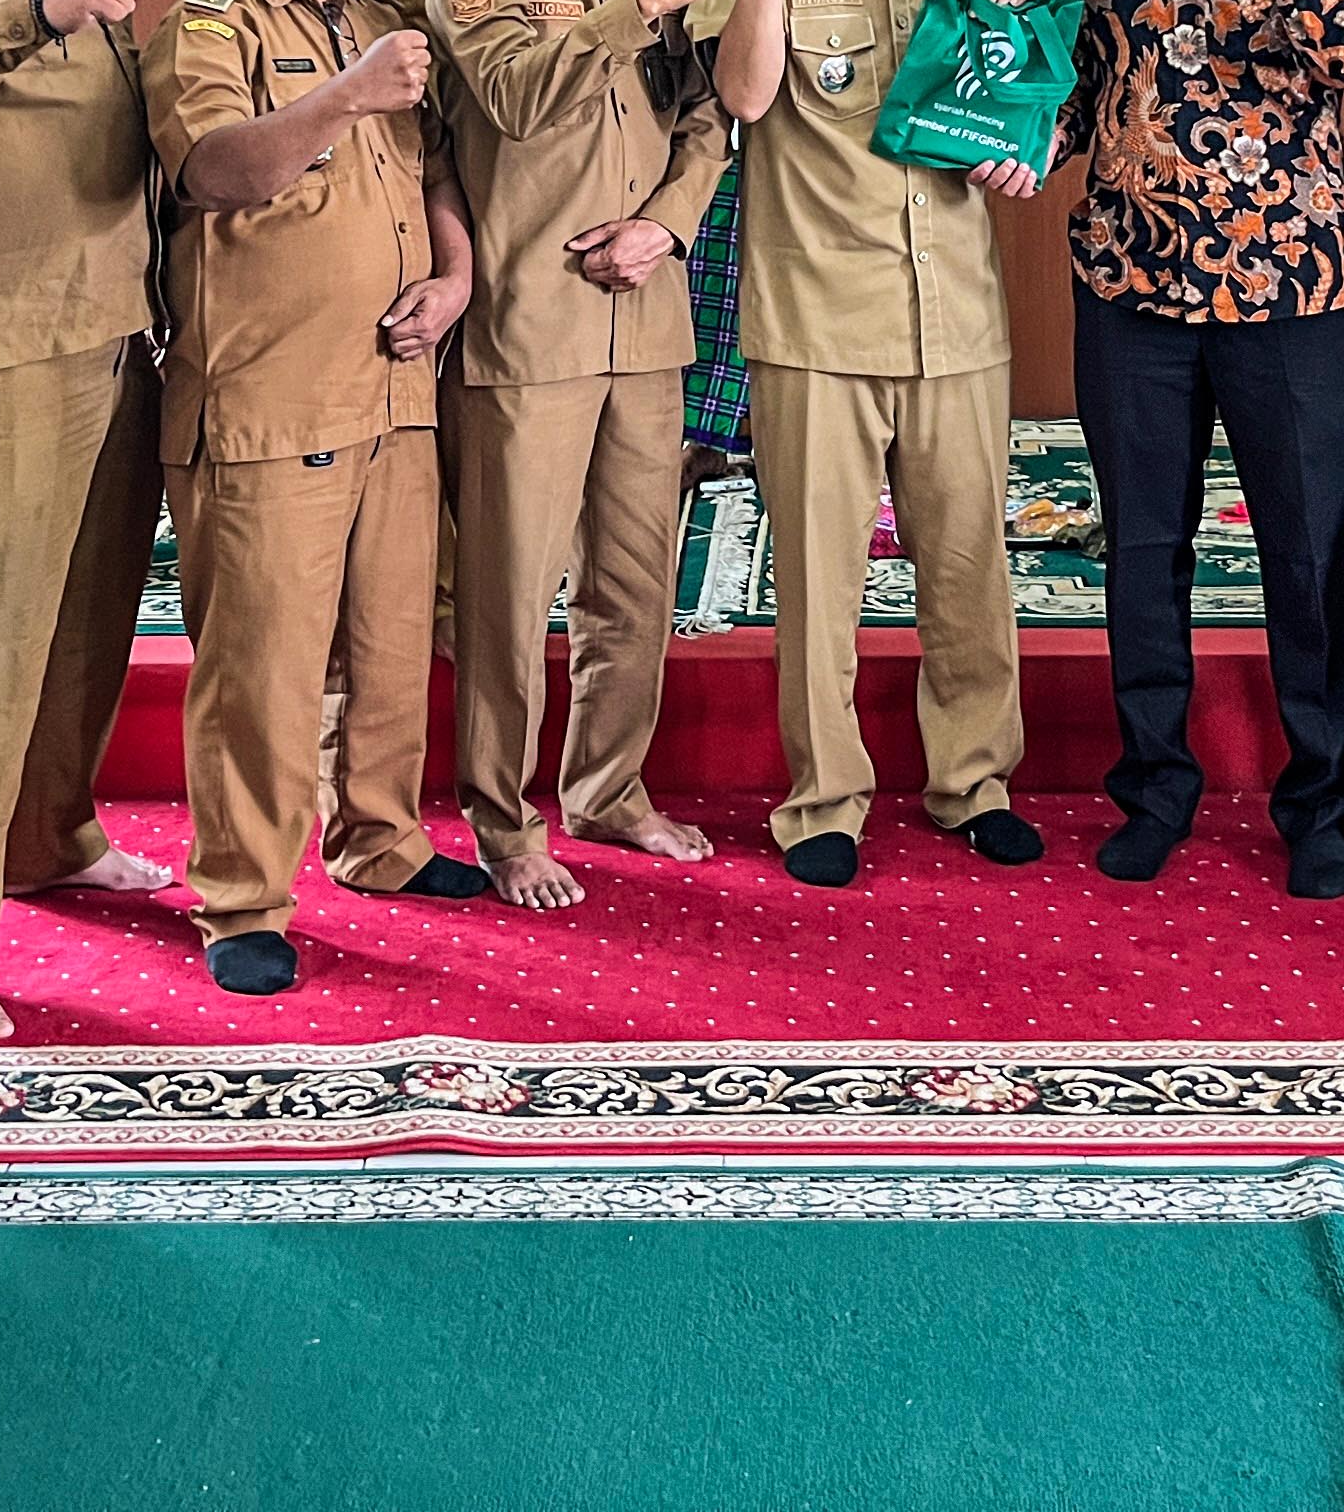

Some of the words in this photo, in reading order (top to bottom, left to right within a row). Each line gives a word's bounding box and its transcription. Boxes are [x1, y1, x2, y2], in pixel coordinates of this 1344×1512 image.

[933, 102, 965, 116] syariah
[965, 109, 1006, 130] financing
[907, 115, 950, 134] member
[949, 127, 962, 137] of
[961, 128, 1019, 153] FIFGROUP
